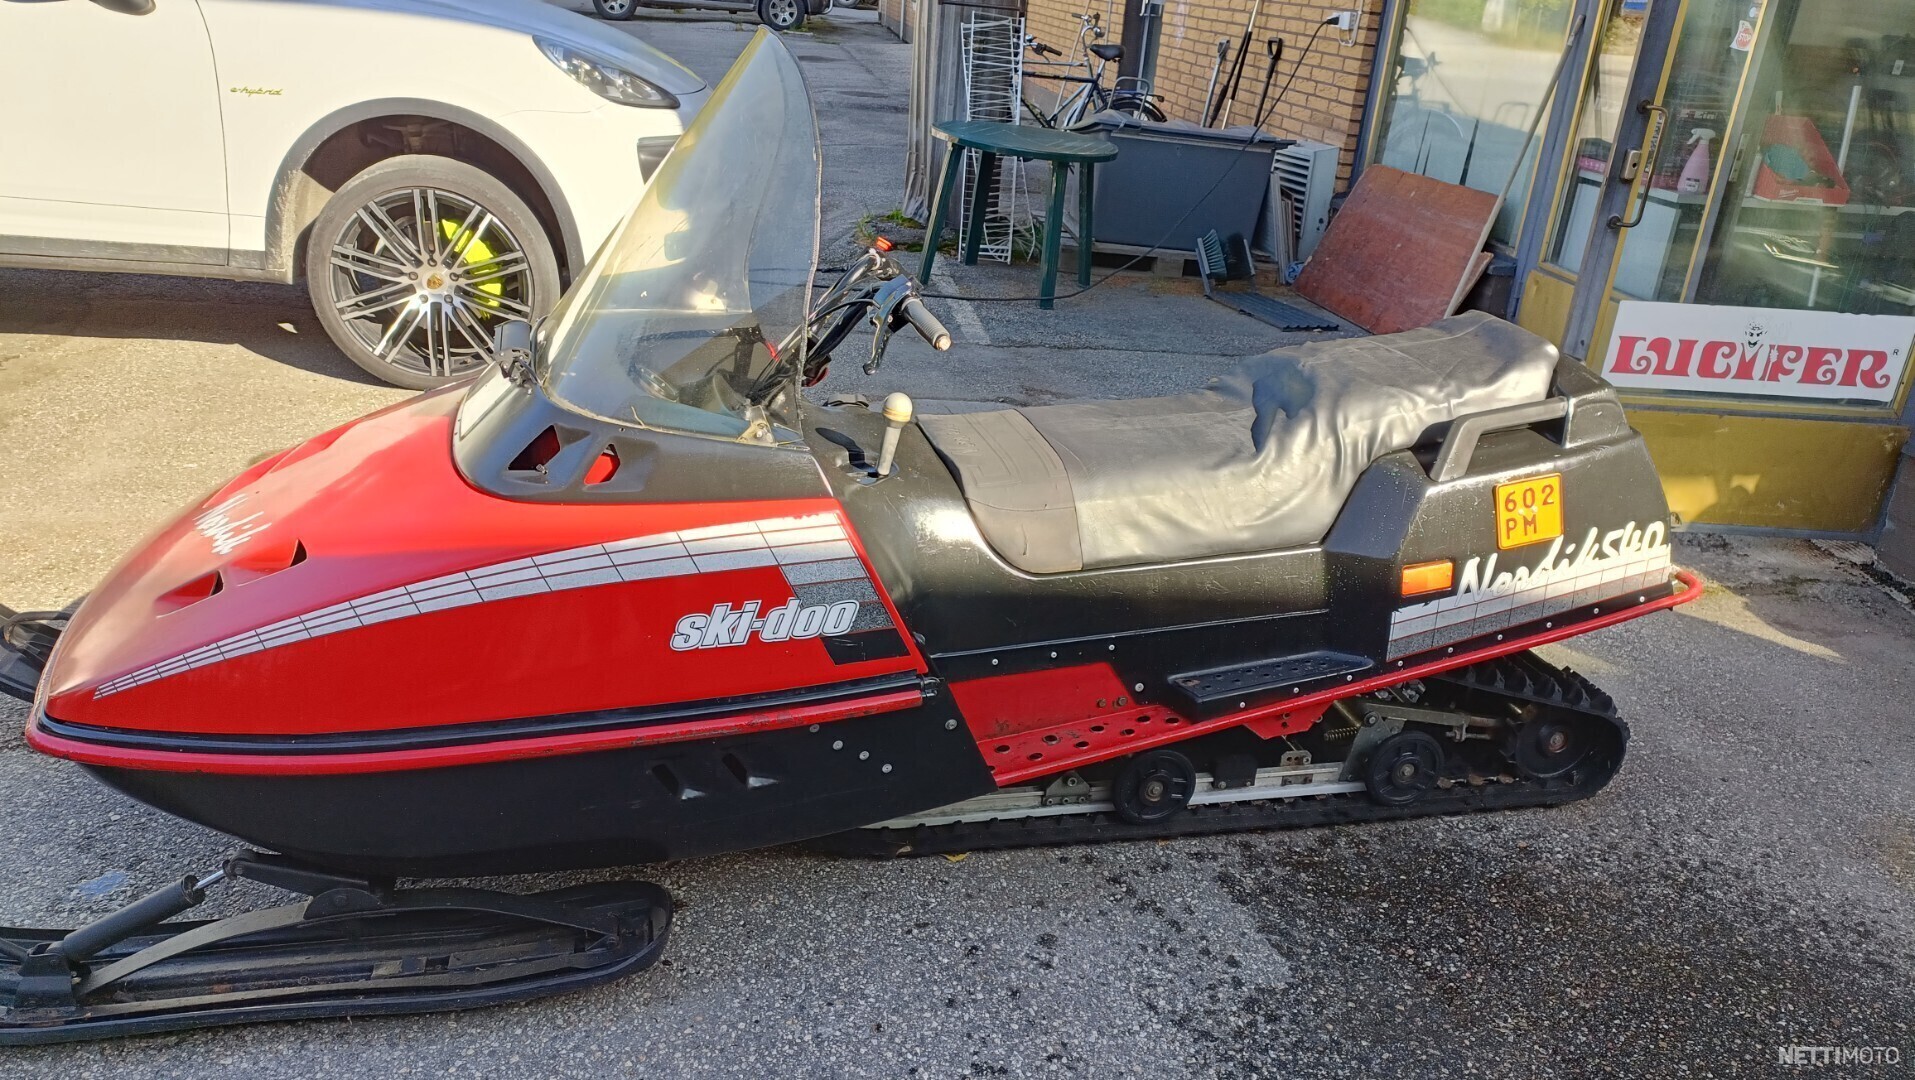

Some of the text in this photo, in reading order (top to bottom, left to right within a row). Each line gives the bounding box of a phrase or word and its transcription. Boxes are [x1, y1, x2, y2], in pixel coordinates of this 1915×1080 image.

[230, 86, 284, 98] e-hybrid
[1609, 335, 1892, 389] LUCIFER
[1504, 483, 1555, 513] 602
[1505, 513, 1538, 540] PM
[670, 597, 860, 652] ski-doo
